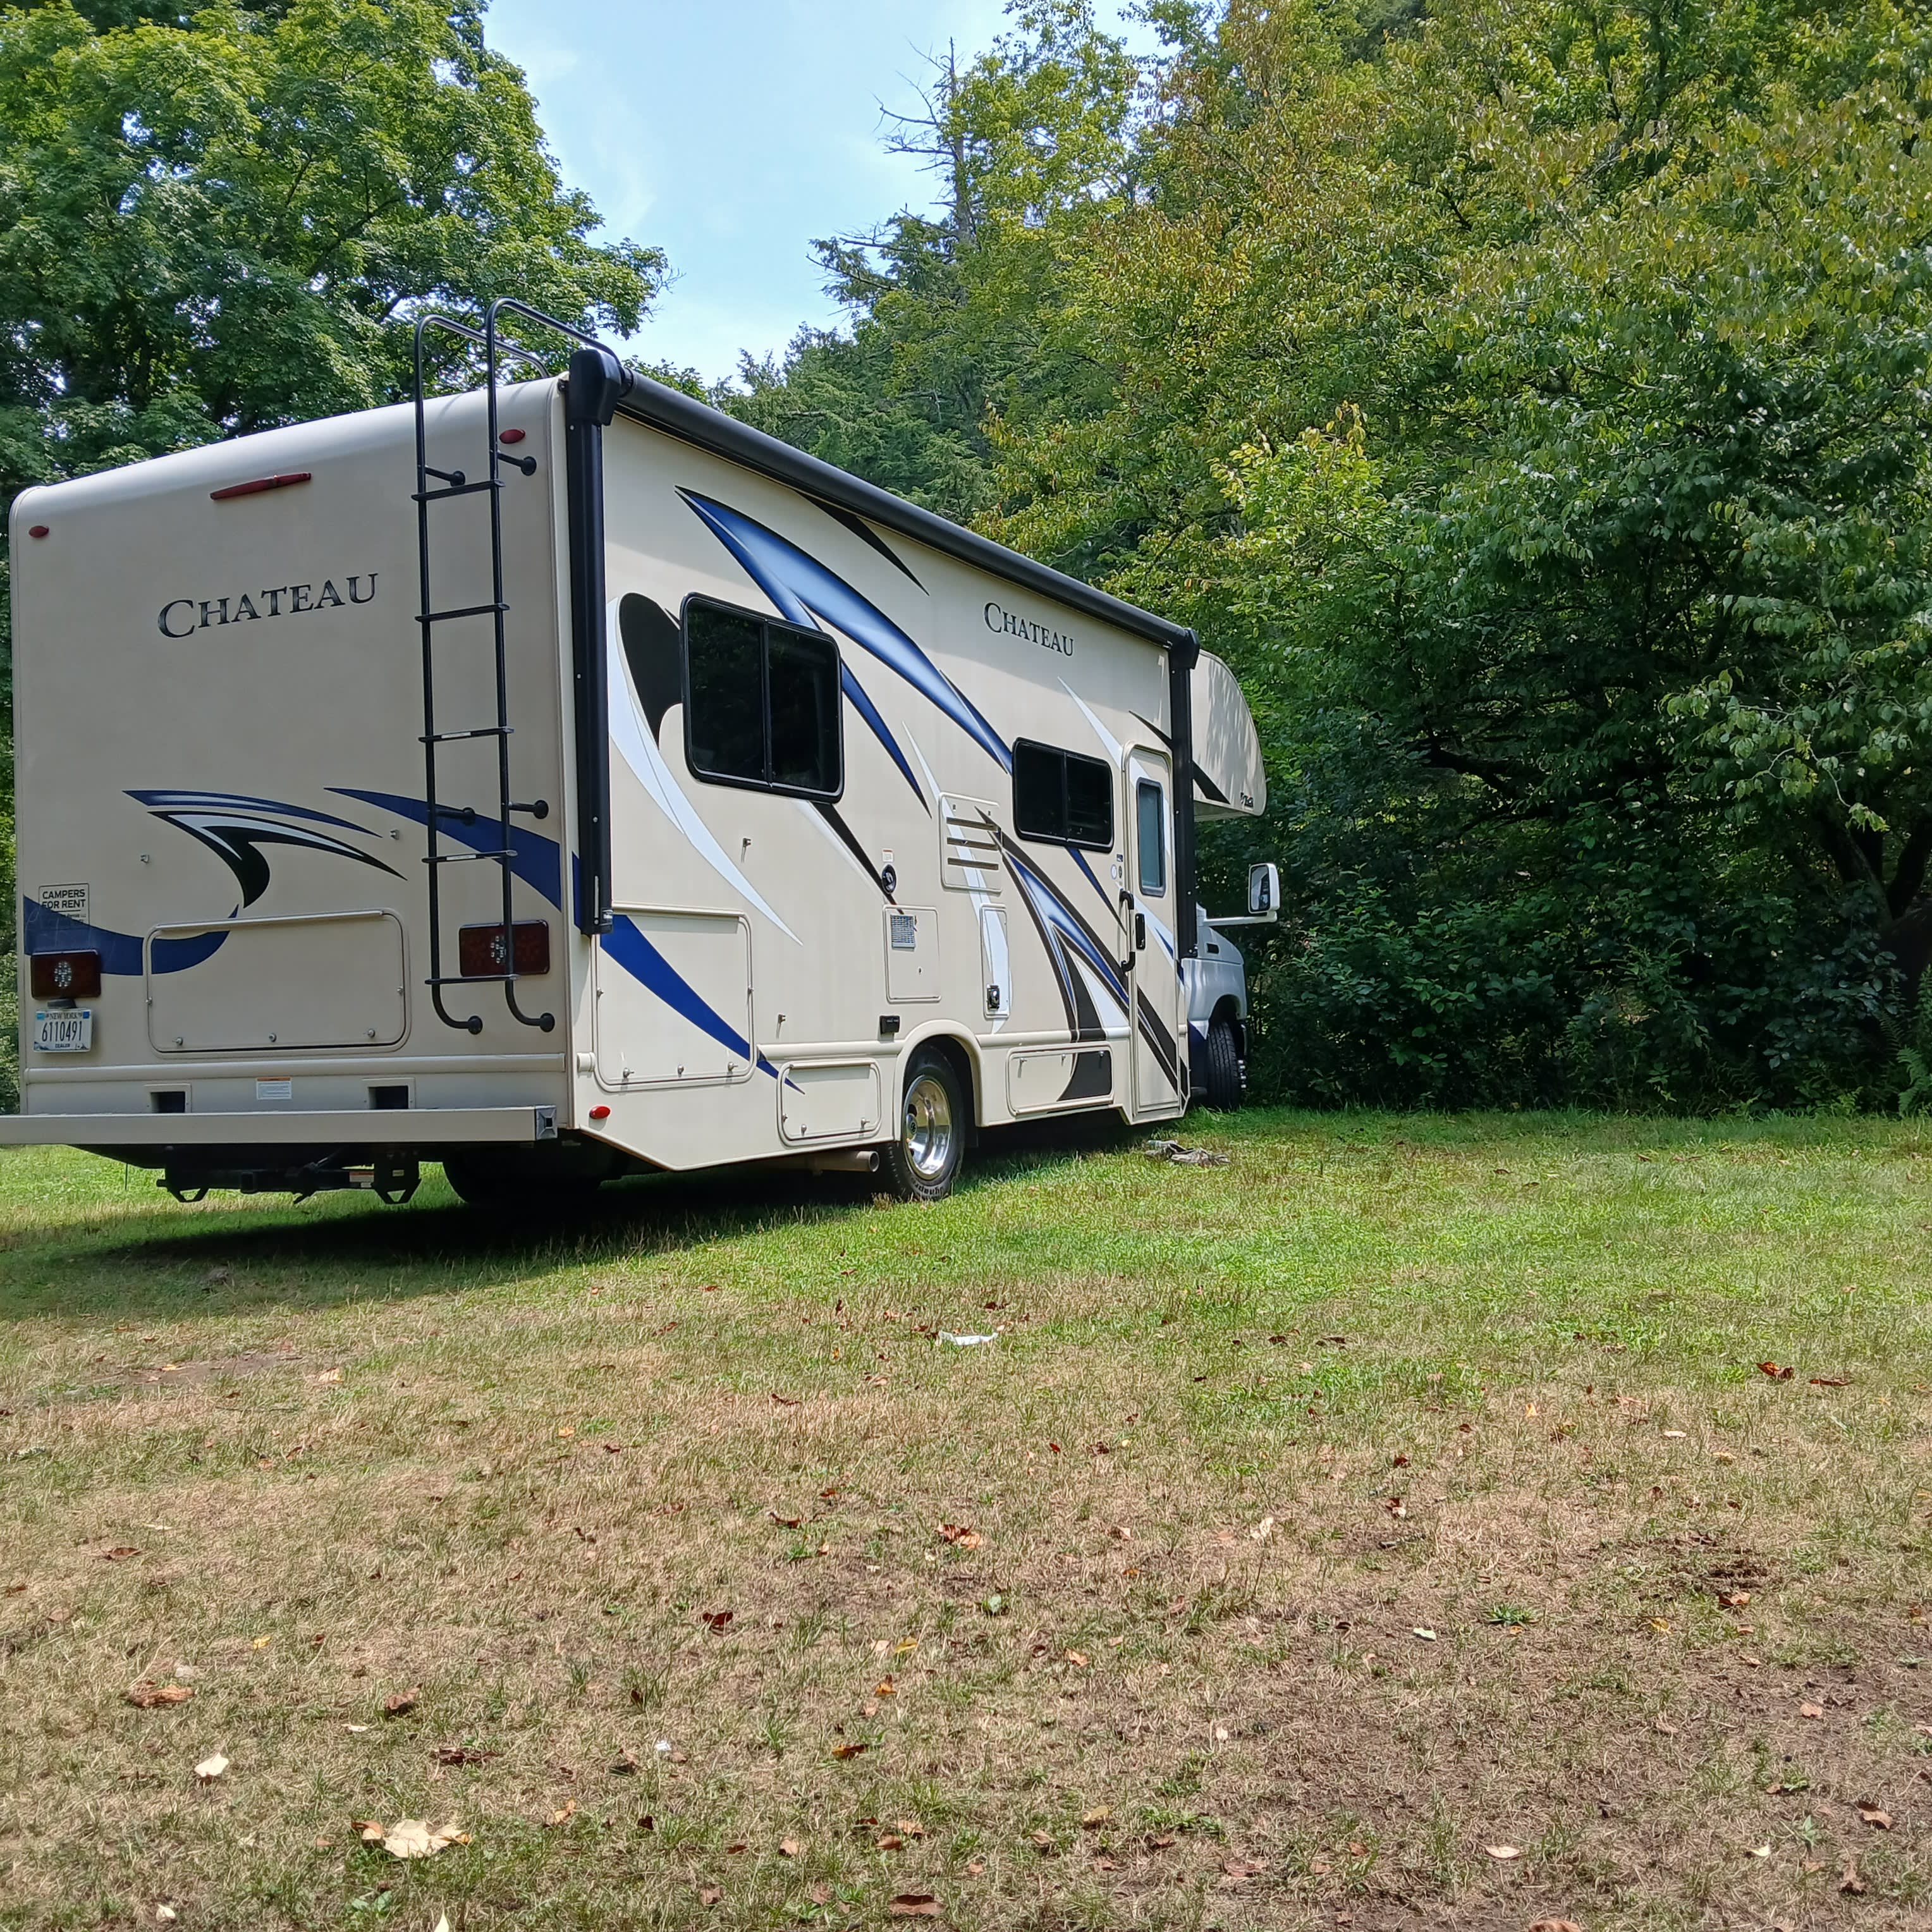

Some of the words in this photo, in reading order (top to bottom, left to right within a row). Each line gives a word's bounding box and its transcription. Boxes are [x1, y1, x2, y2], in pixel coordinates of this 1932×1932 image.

[158, 573, 378, 638] CHATEAU
[984, 602, 1073, 656] CHATEAU
[42, 889, 85, 899] CAMPERS
[42, 900, 59, 909] FOR
[61, 899, 86, 908] RENT
[42, 1020, 82, 1042] 6110491
